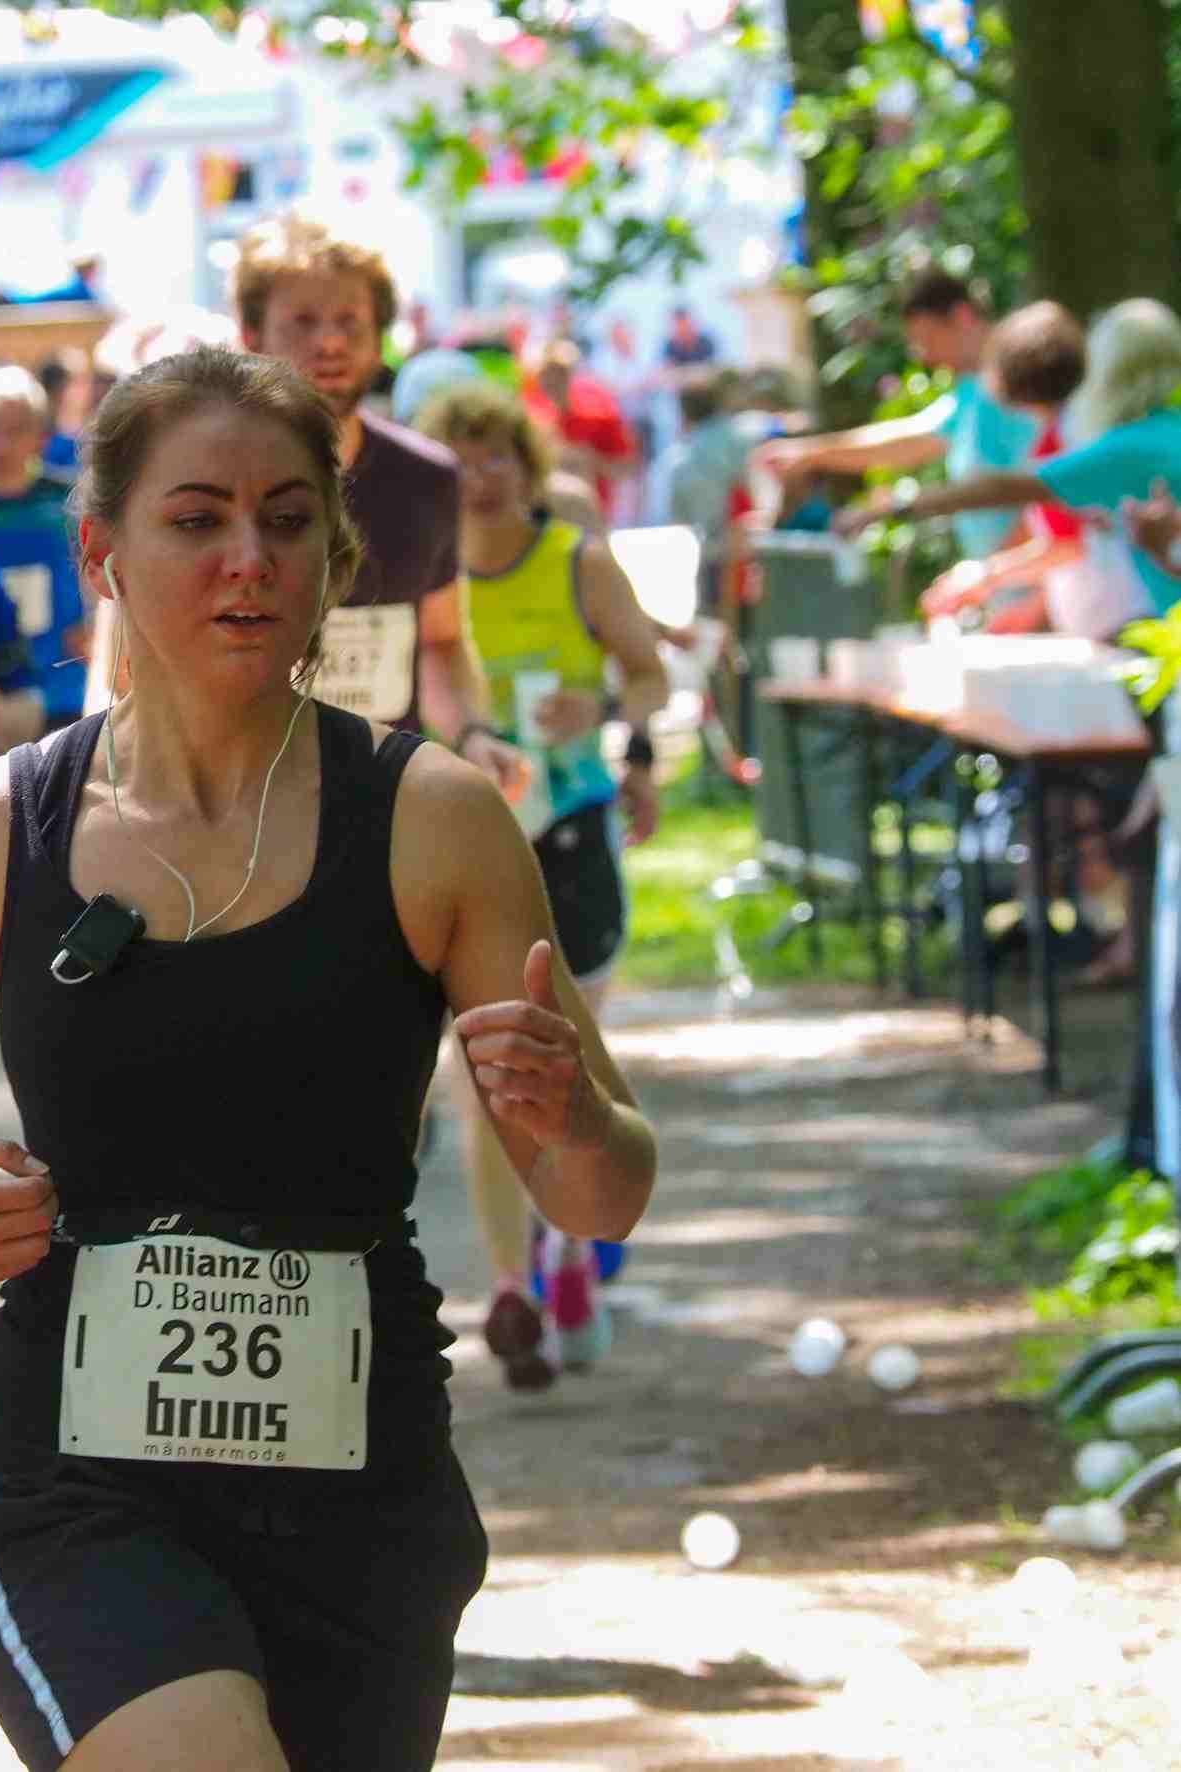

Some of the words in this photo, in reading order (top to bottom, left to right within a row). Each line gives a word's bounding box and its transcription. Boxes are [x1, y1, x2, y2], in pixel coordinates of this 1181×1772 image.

[135, 1244, 260, 1279] Allianz
[133, 1280, 162, 1310] D.
[172, 1282, 310, 1317] Baumann
[156, 1319, 282, 1379] 236
[146, 1380, 288, 1442] bruns
